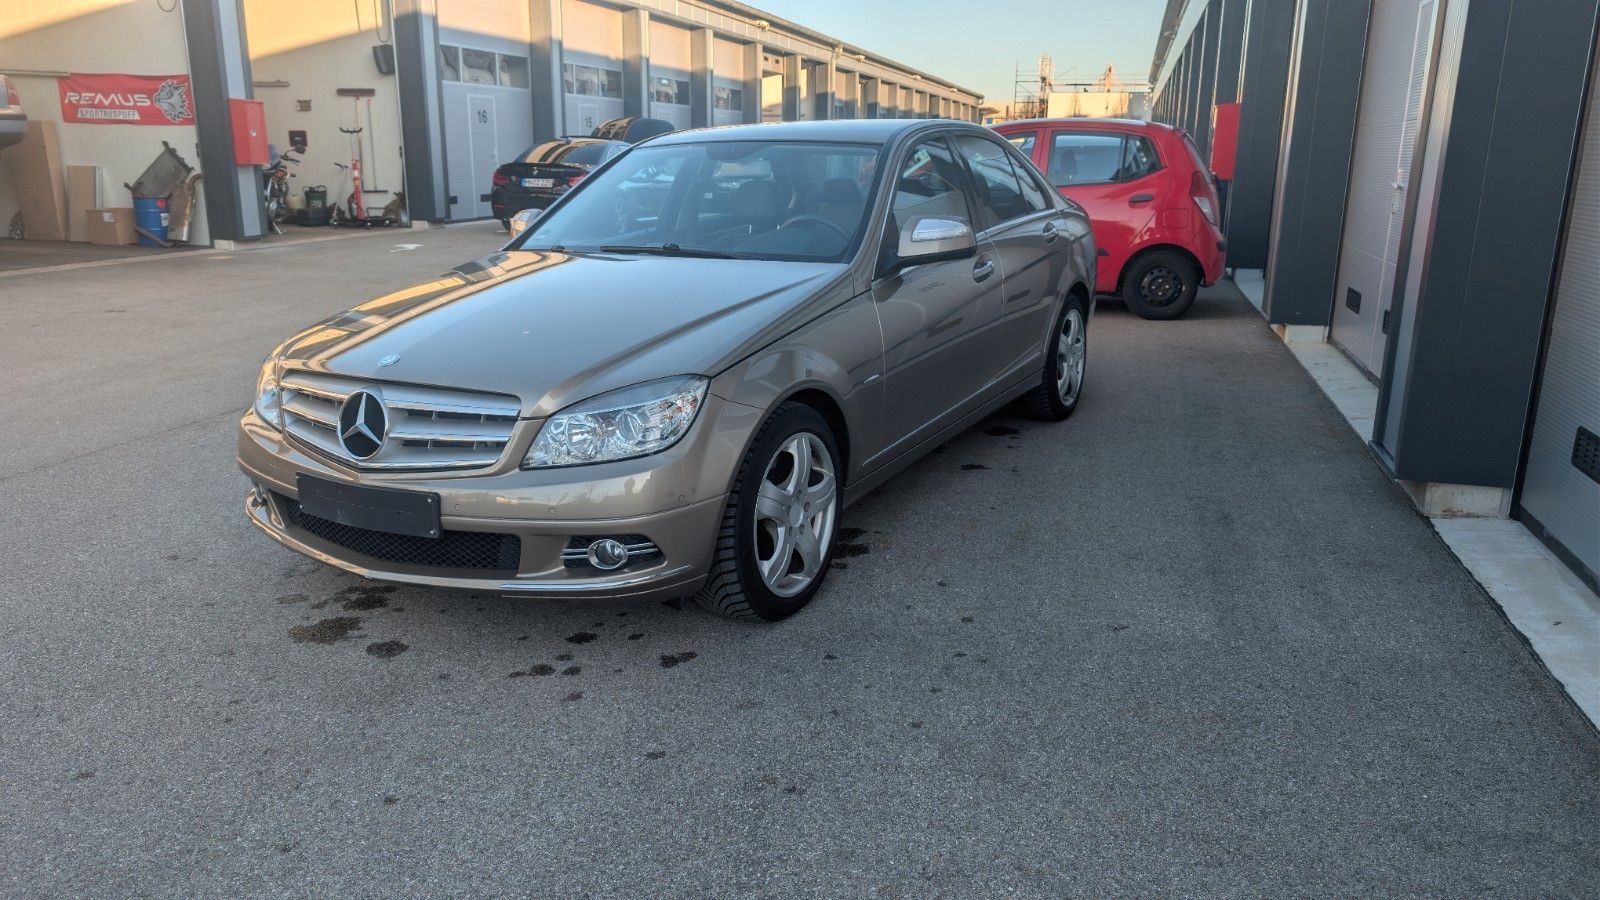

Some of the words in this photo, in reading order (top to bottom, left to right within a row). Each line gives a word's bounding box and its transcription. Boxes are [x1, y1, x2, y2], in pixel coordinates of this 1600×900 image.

[64, 92, 151, 107] REMUS
[477, 110, 488, 124] 16
[585, 117, 593, 129] 15
